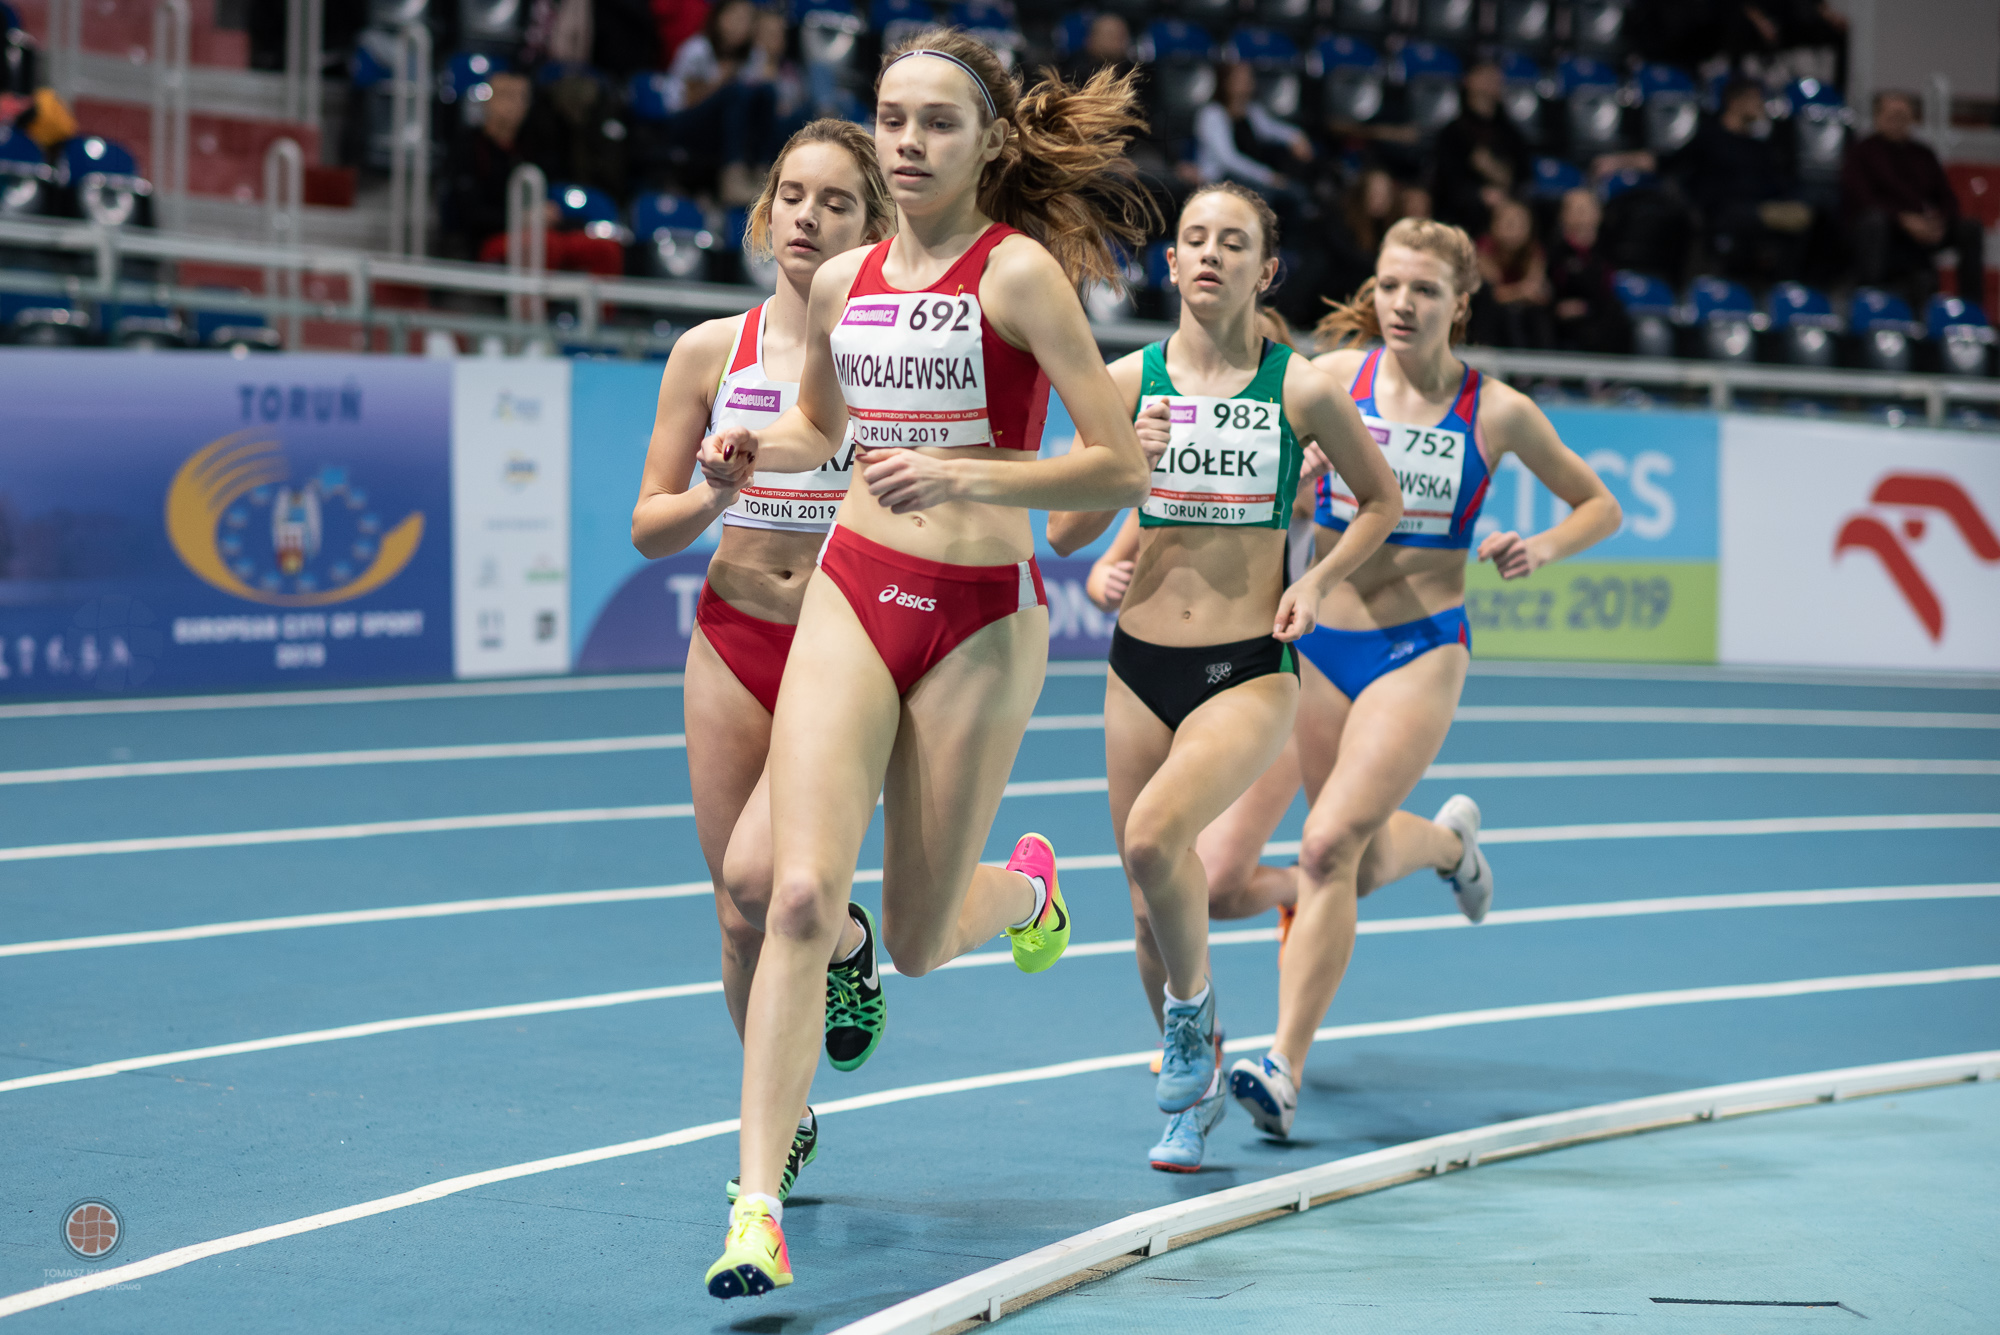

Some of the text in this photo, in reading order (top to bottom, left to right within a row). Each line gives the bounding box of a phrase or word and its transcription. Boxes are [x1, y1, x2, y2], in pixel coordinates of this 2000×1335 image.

[909, 299, 970, 331] 692
[835, 353, 977, 390] MIKOŁAJEWSKA
[962, 411, 979, 419] U20
[1213, 403, 1271, 430] 982
[860, 423, 950, 442] ORUŃ 2019
[1405, 429, 1456, 459] 752
[810, 491, 835, 499] POLSKI
[745, 499, 836, 519] TORUŃ 2019
[1163, 502, 1246, 520] TORUŃ 2019
[895, 591, 938, 612] asics
[1568, 575, 1672, 632] 2019
[173, 615, 278, 644] EUROPEAN
[360, 610, 425, 638] SPORT
